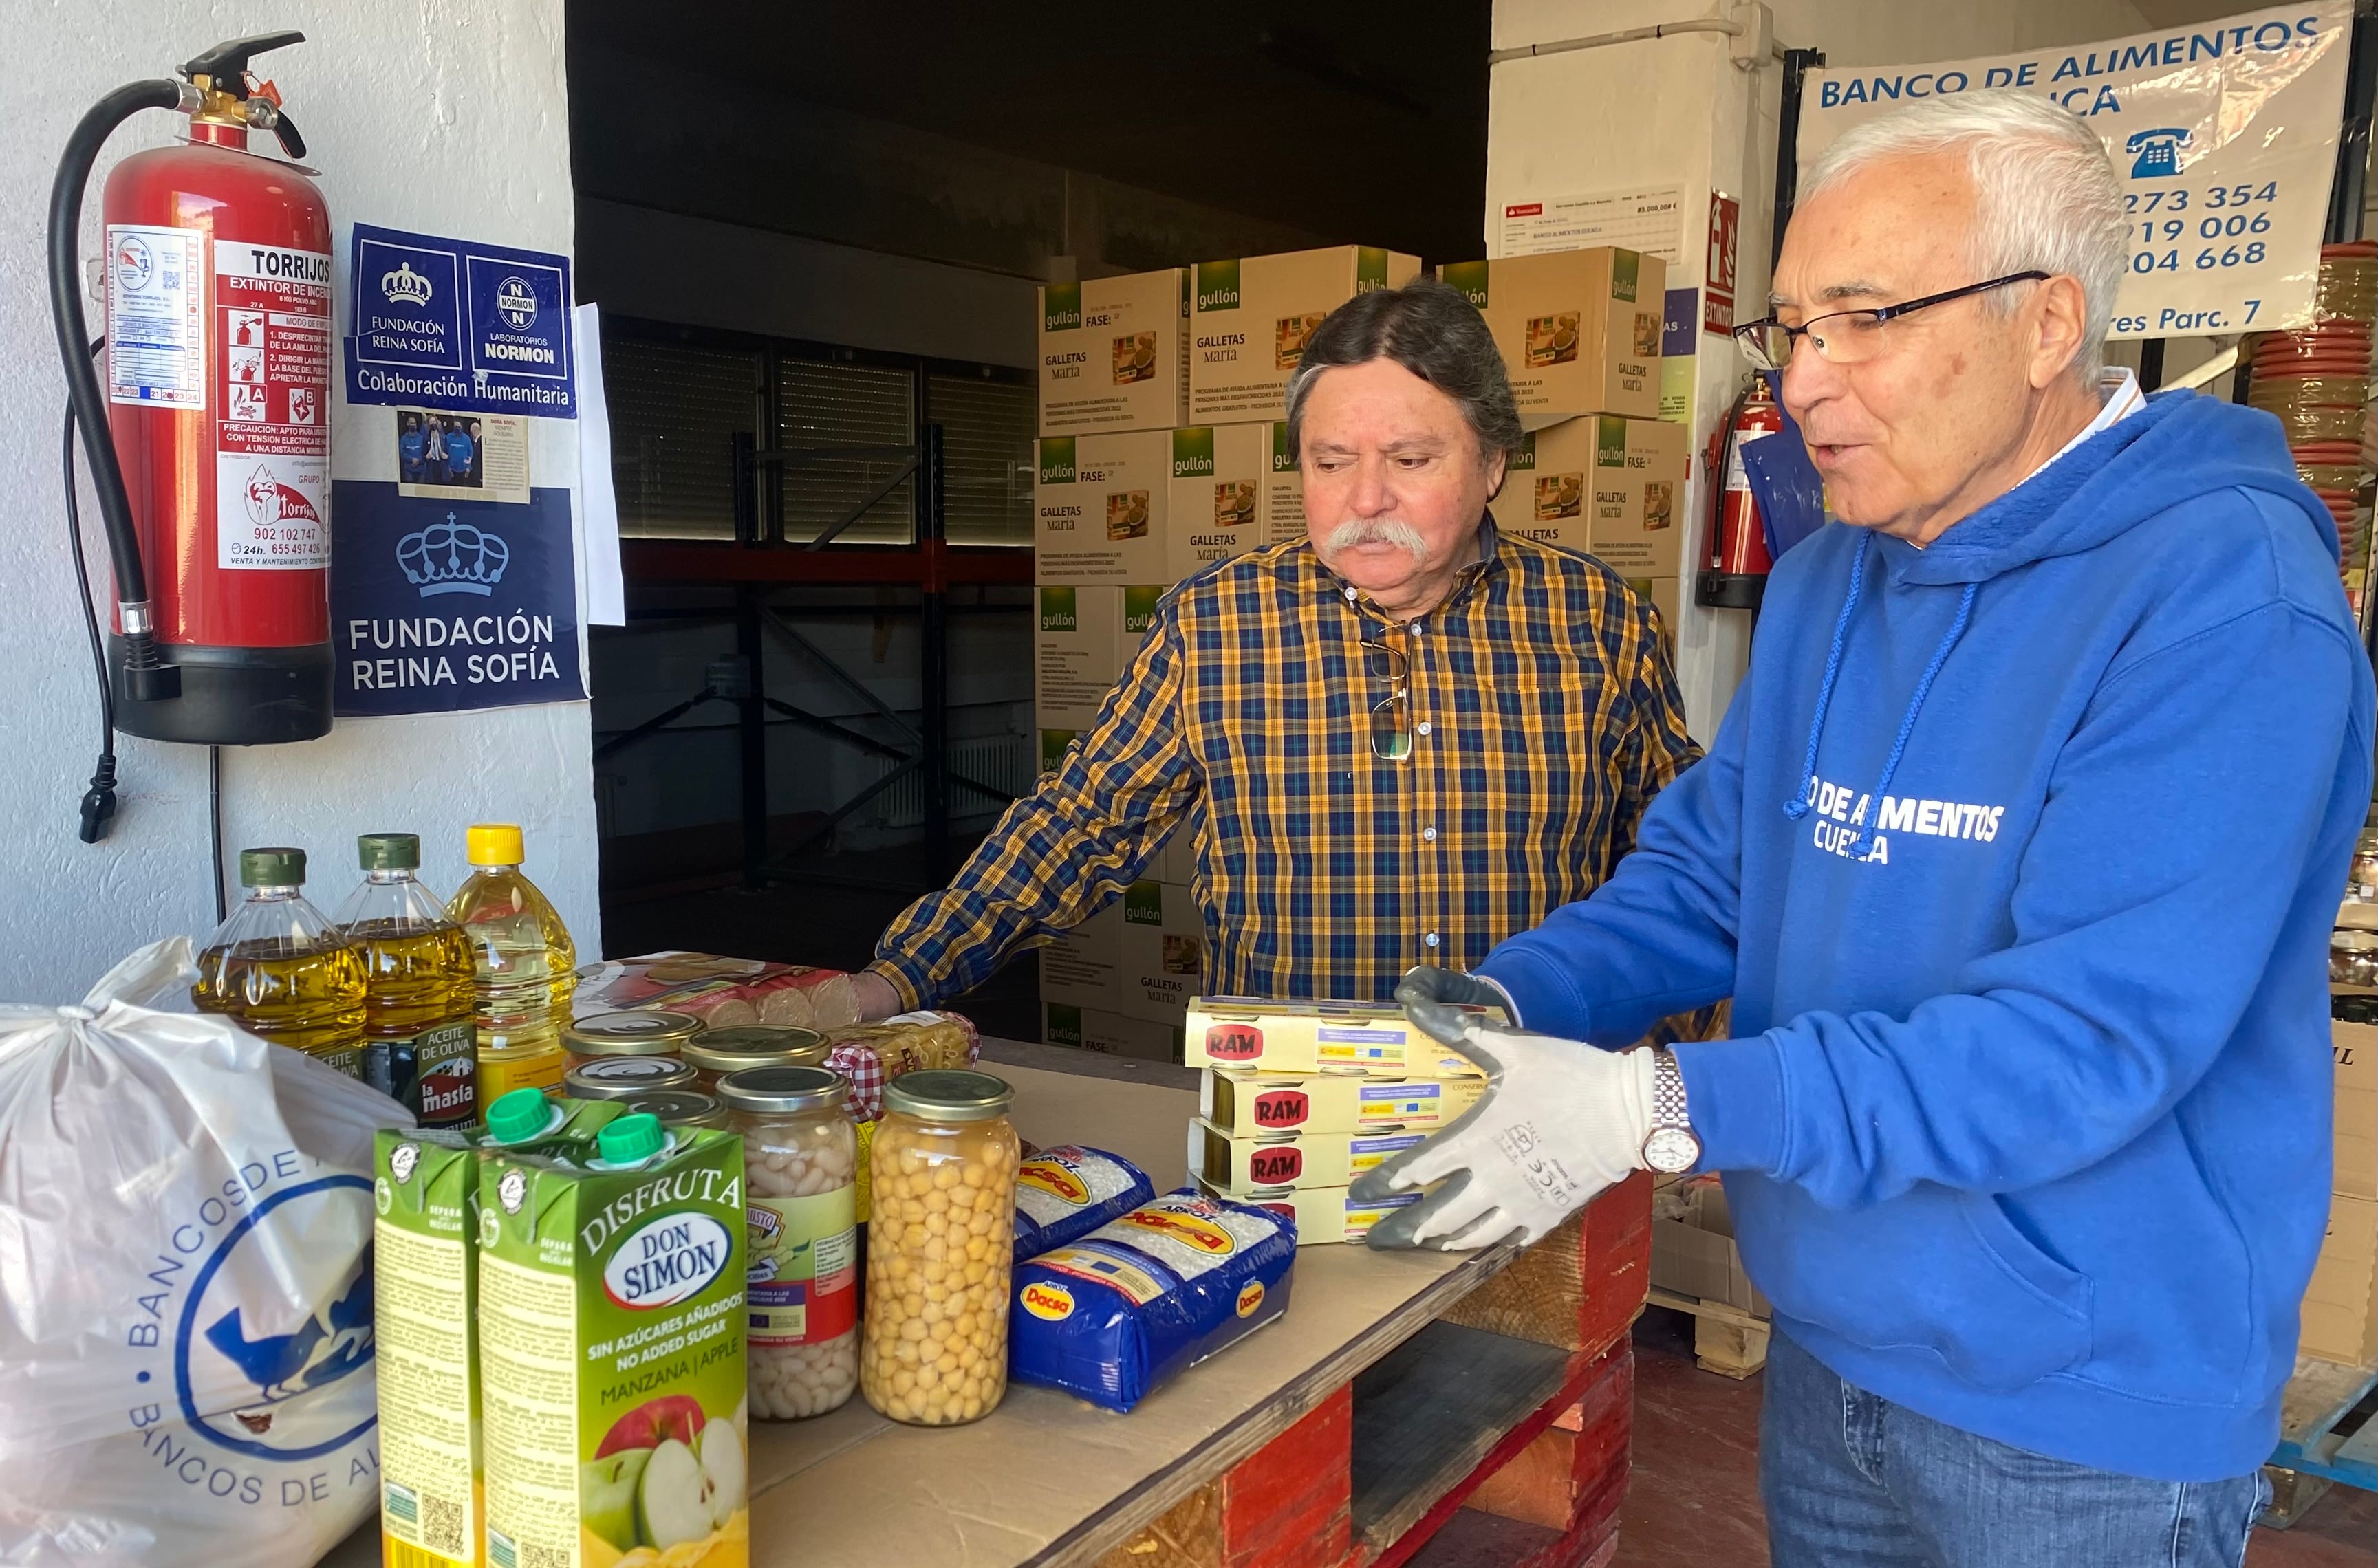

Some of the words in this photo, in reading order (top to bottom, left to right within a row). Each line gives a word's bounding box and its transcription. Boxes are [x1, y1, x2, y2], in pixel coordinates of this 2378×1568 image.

[1821, 72, 1968, 108] BANCO
[1985, 62, 2038, 89] DE
[2051, 17, 2320, 83] ALIMENTOS
[2205, 181, 2278, 208] 354
[2127, 219, 2185, 242] 19
[2200, 212, 2271, 239] 006
[2196, 242, 2266, 269] 668
[251, 250, 329, 283] TORRIJOS
[230, 276, 290, 294] EXTINTOR
[292, 284, 306, 296] DE
[1613, 279, 1636, 298] gullón
[501, 298, 534, 310] NORMON
[1199, 285, 1238, 306] gullón
[286, 317, 307, 326] MODO
[307, 318, 316, 327] DE
[1047, 309, 1080, 329] gullón
[1086, 315, 1111, 328] FASE:
[1706, 301, 1733, 327] EXTINTOR
[2159, 308, 2229, 329] Parc.
[2243, 300, 2262, 325] 7
[269, 331, 277, 339] 1.
[372, 316, 445, 336] FUNDACIÓN
[270, 340, 281, 349] DE
[282, 342, 292, 350] LA
[292, 342, 313, 352] ANILLA
[372, 335, 409, 351] REINA
[411, 338, 445, 354] SOFÍA
[490, 333, 548, 347] LABORATORIOS
[1197, 333, 1245, 348] GALLETAS
[279, 354, 303, 364] DIRIGIR
[485, 343, 554, 364] NORMON
[1046, 352, 1087, 366] GALLETAS
[1204, 346, 1237, 363] María
[270, 363, 281, 371] LA
[281, 364, 300, 373] BASE
[1051, 363, 1080, 380] María
[1618, 362, 1647, 378] GALLETAS
[270, 374, 302, 383] APRETAR
[358, 369, 468, 398] Colaboración
[475, 380, 569, 406] Humanitaria
[252, 388, 264, 400] A
[307, 392, 314, 403] B
[224, 423, 279, 435] PRECAUCION:
[279, 427, 298, 435] APTO
[226, 433, 245, 442] CON
[246, 435, 280, 444] TENSION
[281, 437, 314, 445] ELECTRICA
[271, 446, 305, 454] DISTANCIA
[1599, 446, 1623, 464] gullón
[1175, 455, 1212, 475] gullón
[1628, 457, 1646, 468] FASE:
[298, 475, 320, 484] GRUPO
[1041, 463, 1074, 481] gullón
[1081, 471, 1105, 482] FASE:
[1596, 492, 1626, 503] GALLETAS
[1041, 506, 1081, 517] GALLETAS
[255, 527, 275, 540] 902
[280, 528, 298, 540] 102
[301, 528, 316, 540] 747
[1047, 517, 1074, 532] María
[272, 543, 290, 554] 655
[292, 544, 307, 554] 497
[1190, 534, 1236, 546] GALLETAS
[1196, 547, 1229, 560] María
[349, 608, 553, 650] FUNDACIÓN
[1042, 612, 1074, 629] gullón
[352, 656, 457, 690] REINA
[466, 646, 560, 684] SOFÍA
[1817, 781, 1854, 822] DE
[1849, 794, 2004, 842] AMENTOS
[1126, 906, 1160, 921] gullón
[1141, 977, 1182, 992] GALLETAS
[427, 1027, 464, 1045] ACEITE
[1049, 1027, 1080, 1041] gullón
[1209, 1032, 1255, 1054] RAM
[422, 1047, 437, 1060] DE
[440, 1039, 471, 1056] OLIVA
[1085, 1041, 1108, 1052] FASE:
[422, 1084, 433, 1098] la
[422, 1084, 473, 1113] masía
[1257, 1100, 1302, 1121] RAM
[1252, 1155, 1298, 1177] RAM
[429, 1205, 463, 1216] SEPARA
[580, 1168, 740, 1257] DISFRUTA
[747, 1208, 774, 1228] USTO
[1162, 1205, 1218, 1223] ARROZ
[128, 1180, 248, 1347] BANCOS
[239, 1150, 301, 1191] DE
[641, 1222, 692, 1260] DON
[624, 1241, 716, 1301] SIMON
[1026, 1288, 1069, 1314] Dacsa
[1239, 1289, 1262, 1311] Dacsa
[588, 1341, 613, 1361] SIN
[616, 1316, 683, 1352] AZÚCARES
[685, 1292, 743, 1327] AÑADIDOS
[616, 1353, 638, 1372] NO
[641, 1336, 684, 1364] ADDED
[687, 1318, 728, 1346] SUGAR
[601, 1360, 690, 1406] MANZANA
[700, 1338, 738, 1369] APPLE
[281, 1472, 329, 1507] DE
